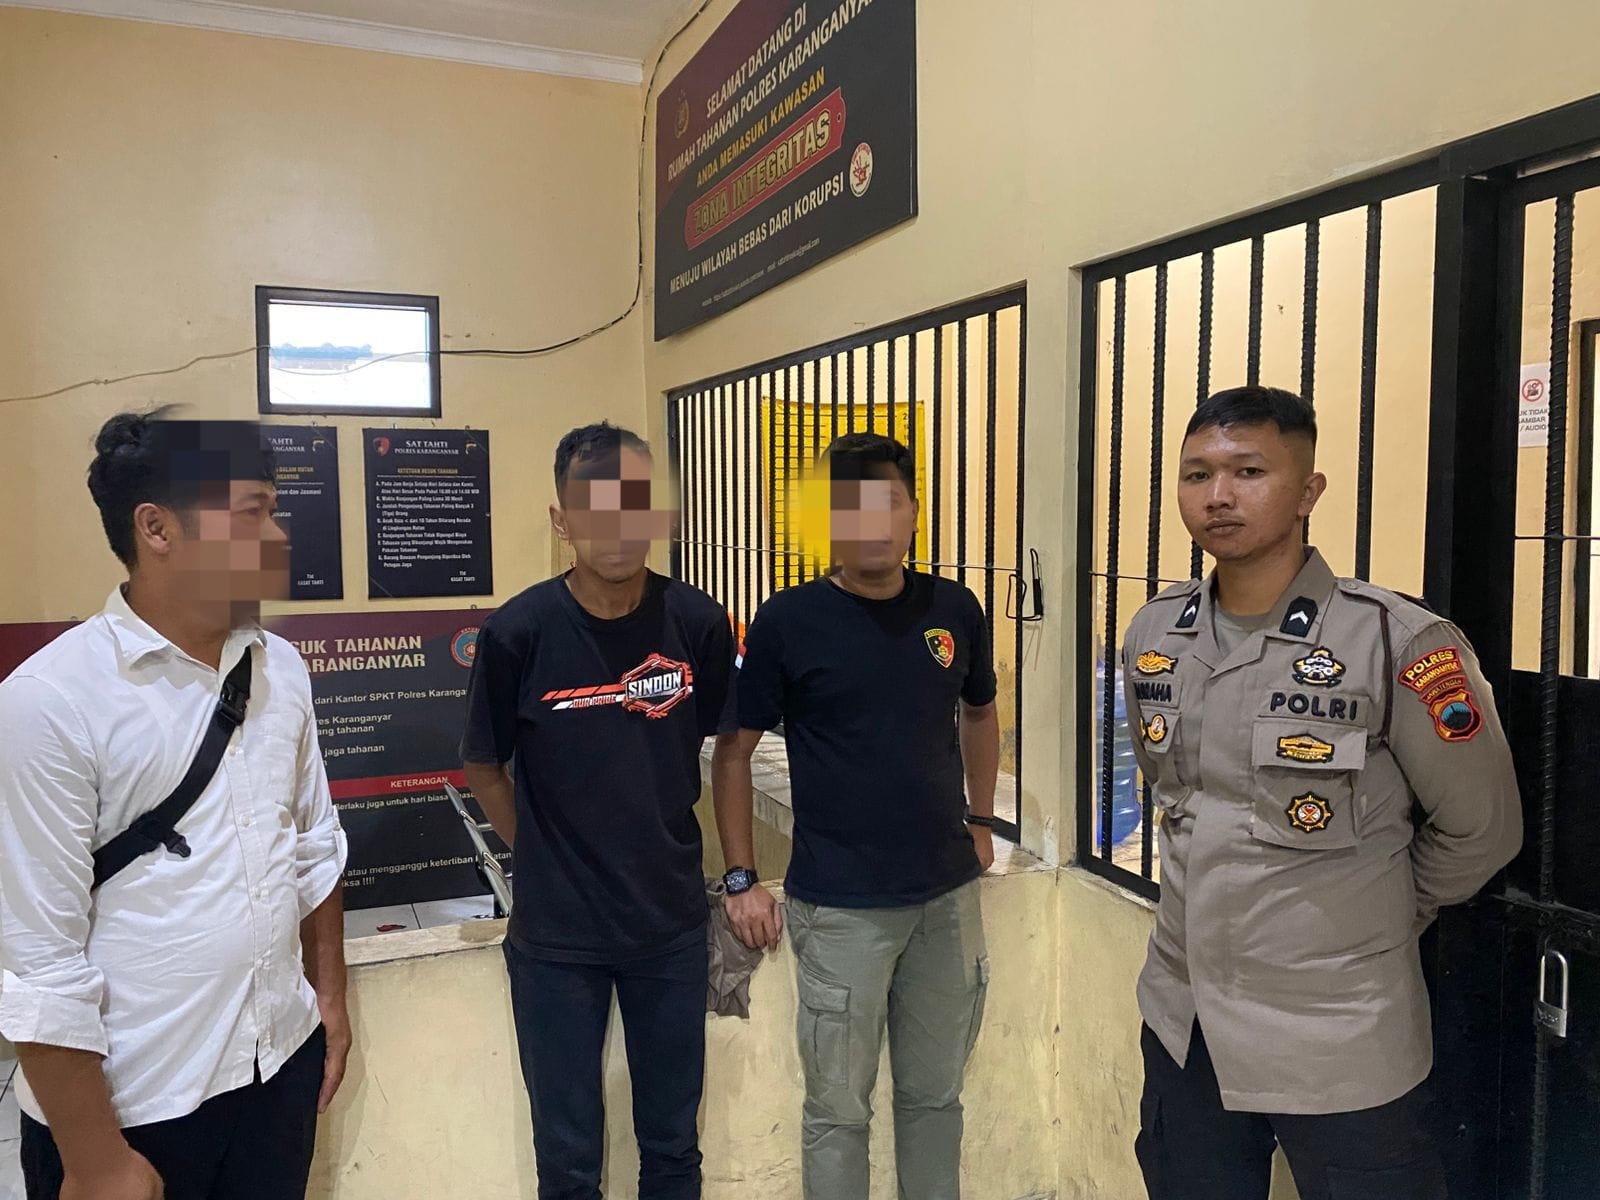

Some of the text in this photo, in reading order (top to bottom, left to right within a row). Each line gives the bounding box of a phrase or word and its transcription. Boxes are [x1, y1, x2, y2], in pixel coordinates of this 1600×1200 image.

[706, 2, 807, 118] SELAMAT DATANG DI
[667, 143, 696, 182] RUMAH
[696, 104, 739, 156] TAHANAN
[740, 70, 776, 117] POLRES
[696, 66, 825, 188] ANDA MEMASUKI KAWASAN
[693, 108, 831, 237] ZONA INTEGRITAS
[669, 264, 700, 294] MENUJU
[701, 242, 737, 277] WILAYAH
[738, 221, 767, 256] BEBAS
[769, 204, 791, 236] DARI
[794, 171, 844, 219] KORUPSI
[405, 440, 448, 449] SAT TAHTI
[334, 635, 422, 653] TAHANAN
[1404, 650, 1454, 681] POLRES
[628, 671, 682, 699] SINDON
[314, 688, 467, 705] dari Kantor SPKT Polres Karanga
[1269, 691, 1358, 721] POLRI
[332, 712, 393, 725] Karanganyar
[336, 724, 375, 735] tahanan
[324, 744, 385, 758] jaga tahanan
[390, 776, 449, 788] KETERANGAN
[366, 800, 385, 810] juga
[386, 797, 410, 806] untuk
[410, 796, 427, 804] hari
[428, 794, 449, 802] biasa
[348, 867, 367, 877] atau
[369, 860, 429, 875] mengganggu
[429, 855, 474, 868] ketertiban
